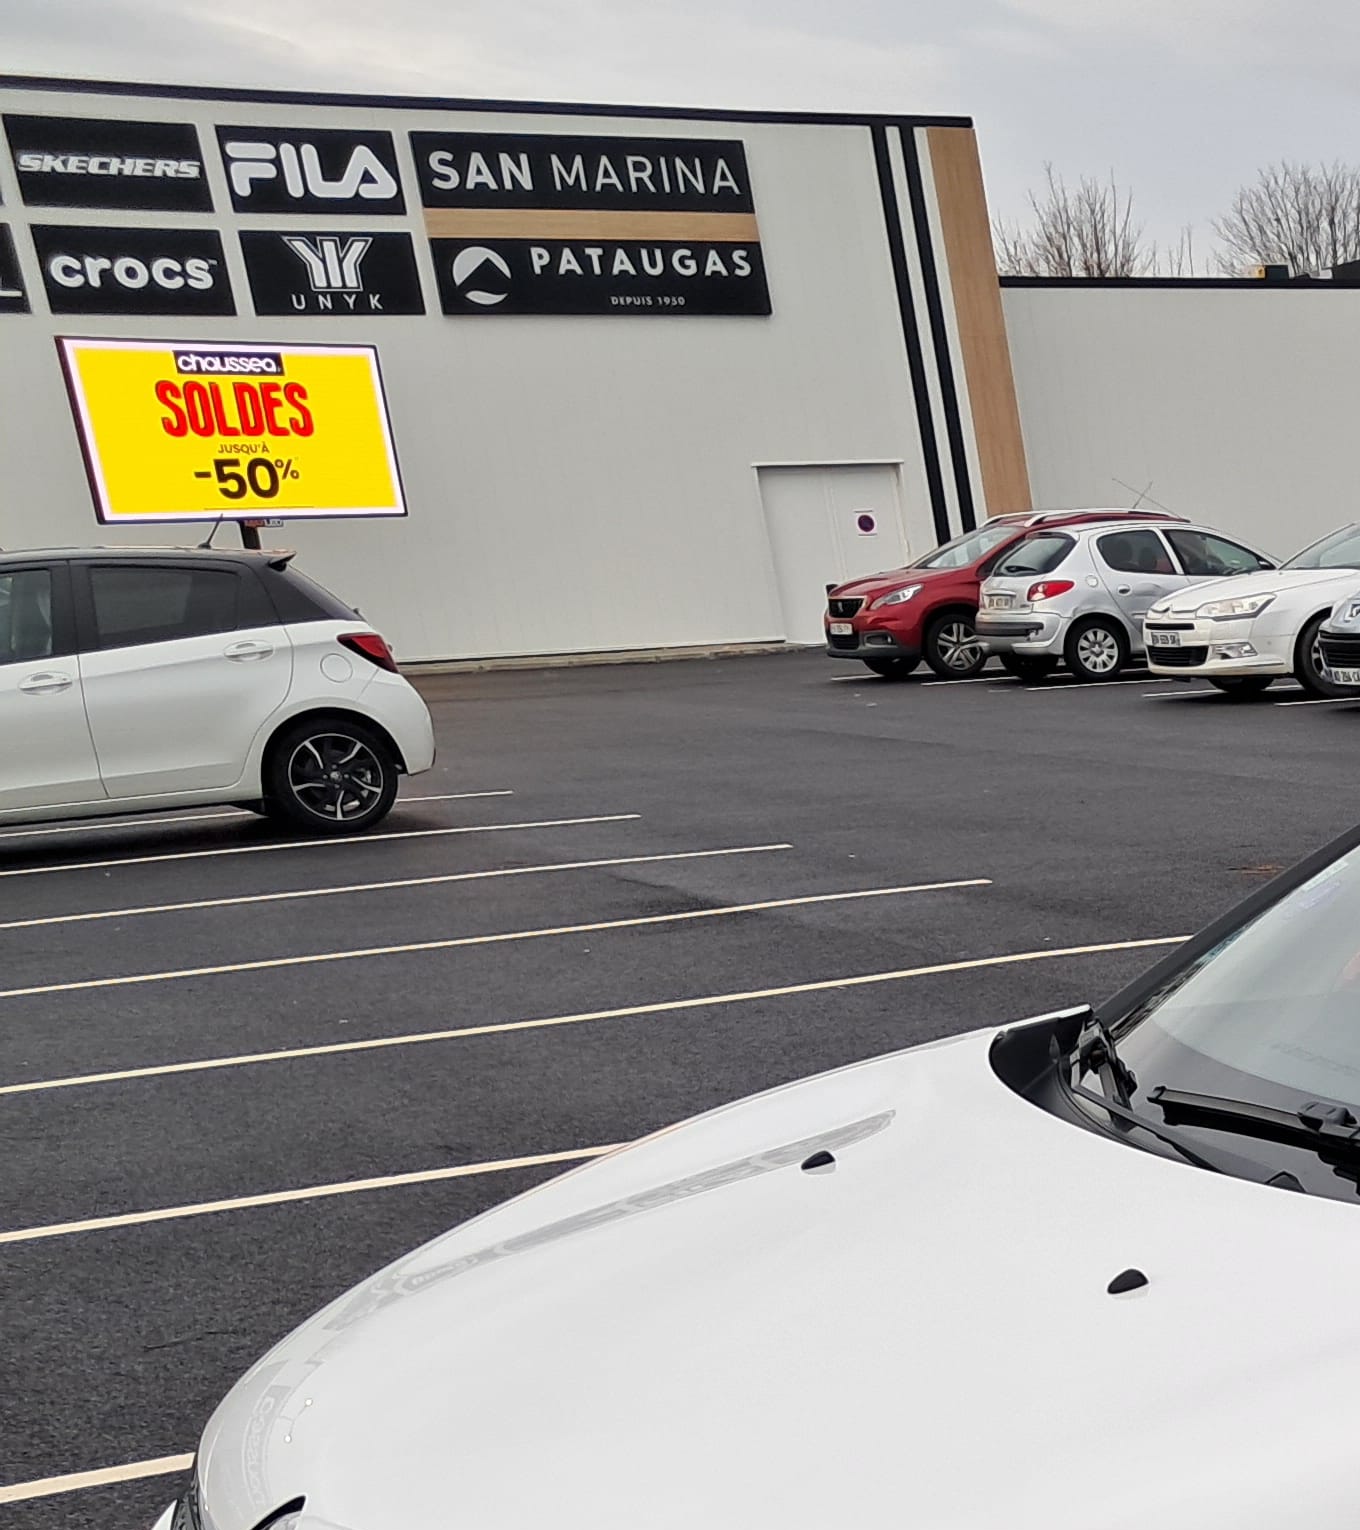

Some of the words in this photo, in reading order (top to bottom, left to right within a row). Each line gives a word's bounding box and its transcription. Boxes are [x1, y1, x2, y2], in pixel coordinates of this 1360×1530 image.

[18, 153, 201, 179] SKECHERS
[225, 141, 398, 199] FILA
[428, 150, 534, 191] SAN
[550, 153, 742, 196] MARINA
[49, 254, 214, 290] crocs
[530, 247, 752, 277] PATAUGAS
[291, 294, 384, 310] UNYK
[610, 295, 653, 306] DEPUIS
[177, 353, 277, 373] chaussea
[154, 379, 315, 438] SOLDES
